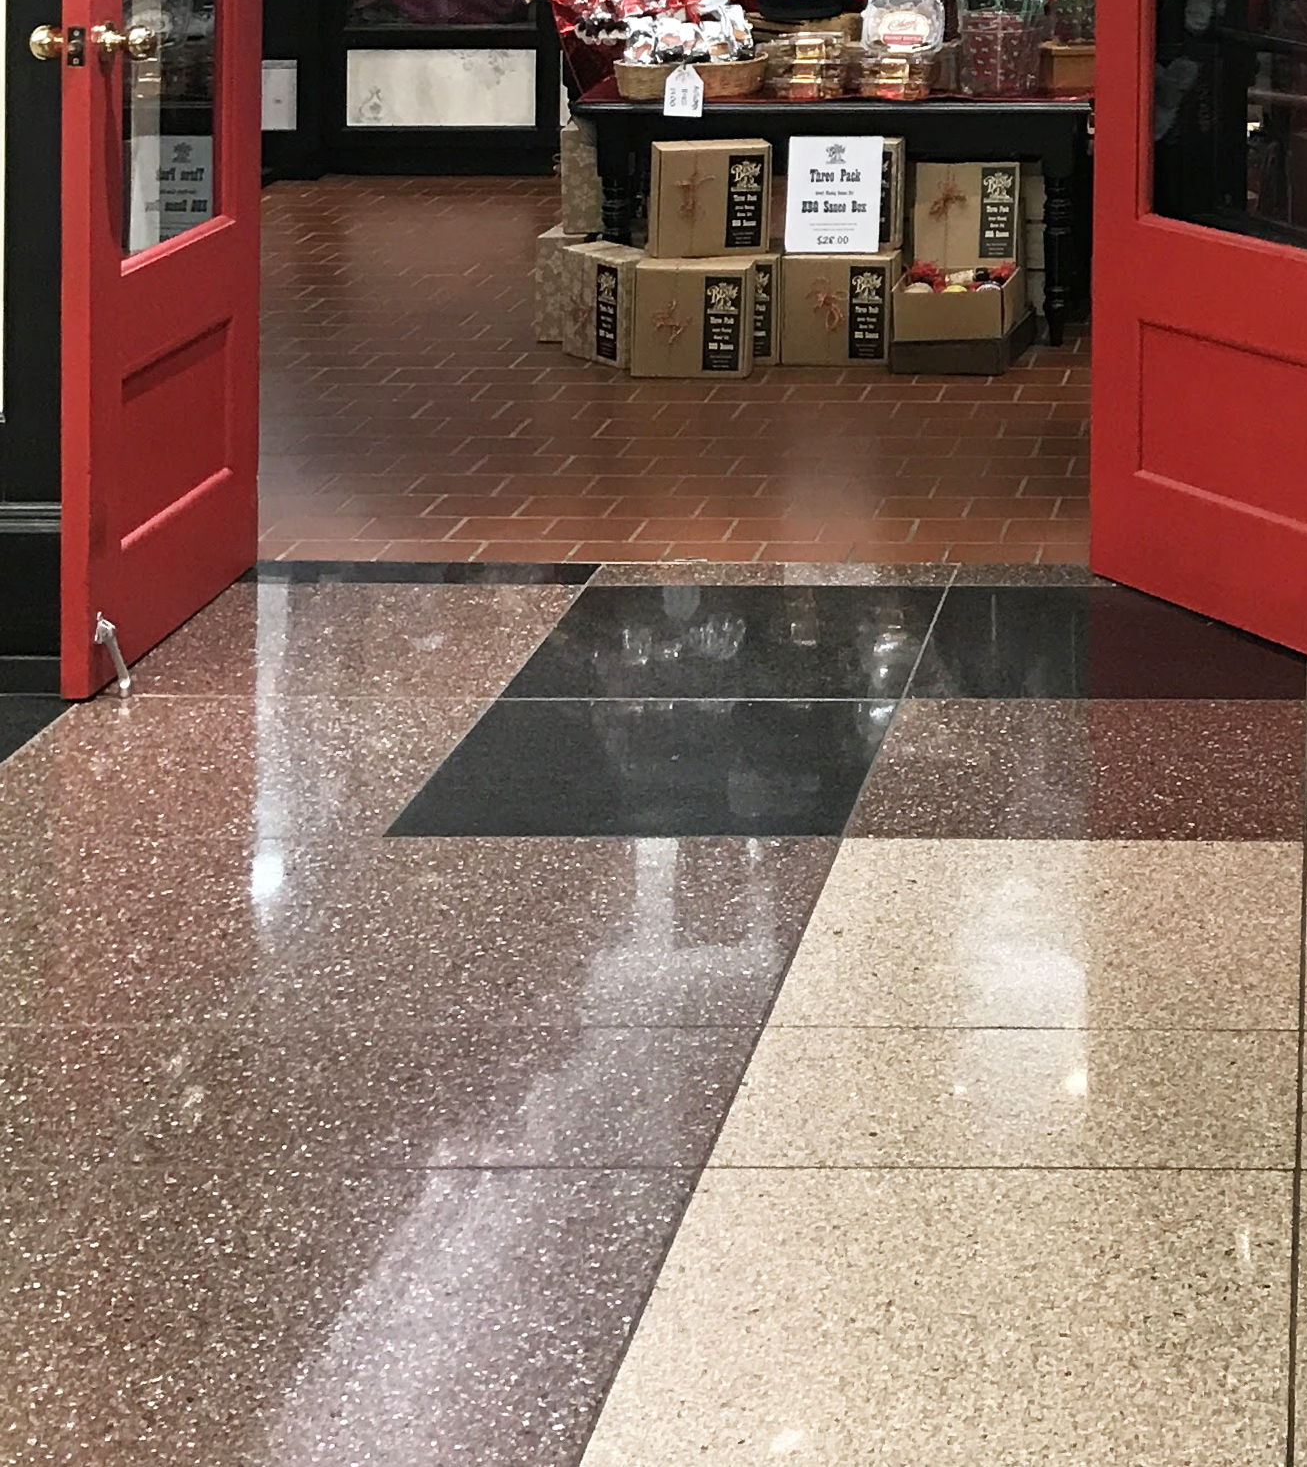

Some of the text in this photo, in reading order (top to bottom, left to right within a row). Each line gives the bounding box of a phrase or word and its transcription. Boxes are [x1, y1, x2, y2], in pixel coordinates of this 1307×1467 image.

[810, 169, 861, 182] Three Pack
[823, 200, 846, 213] Sauce
[851, 200, 867, 213] Box
